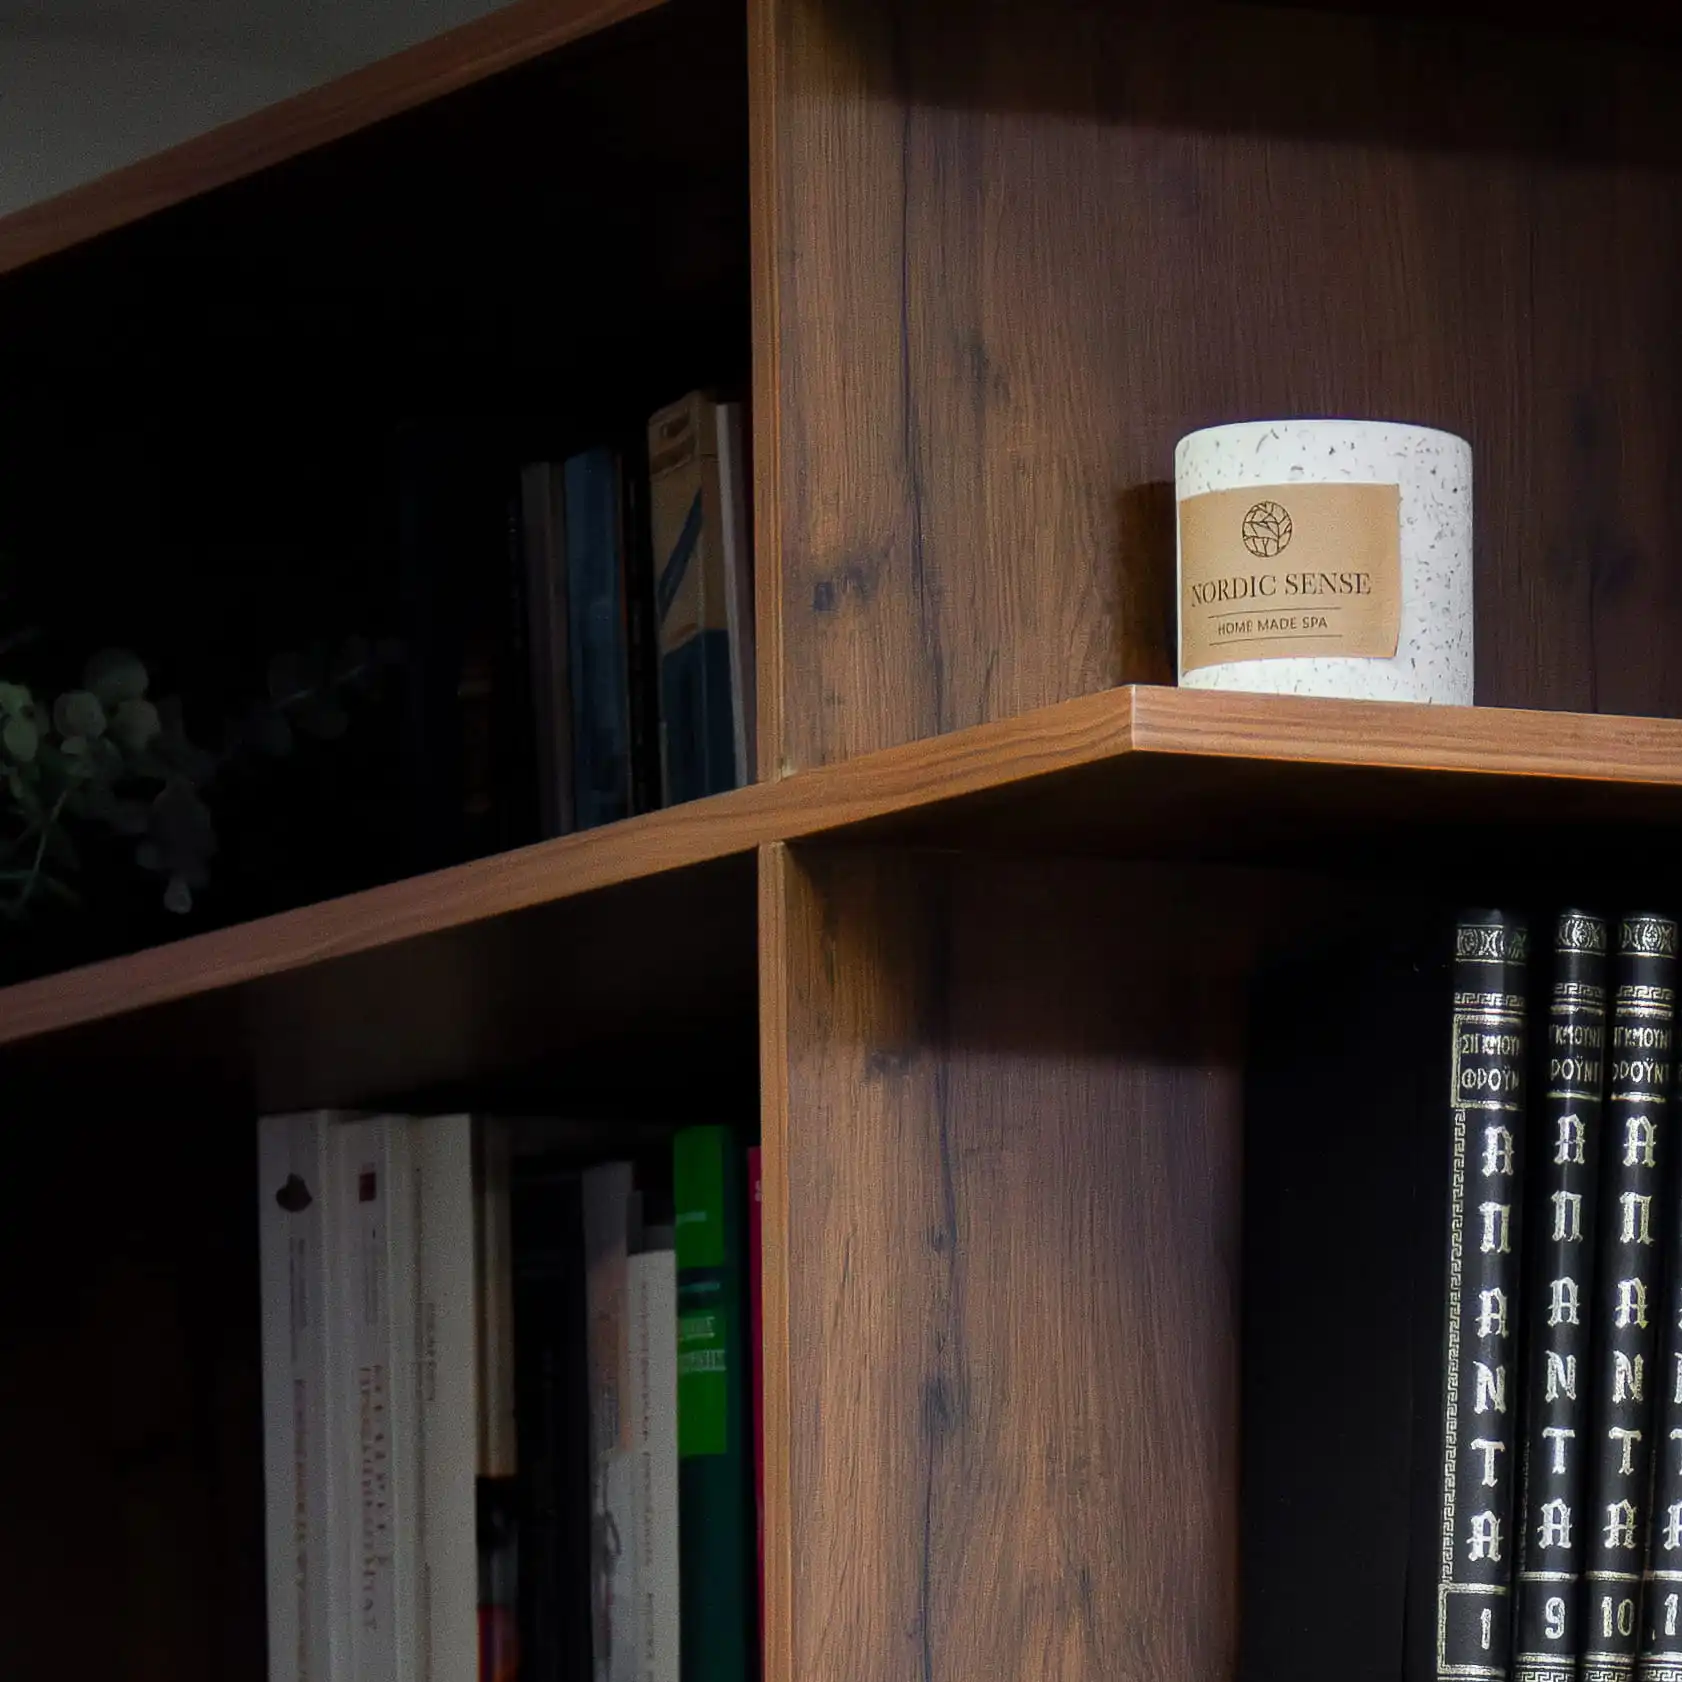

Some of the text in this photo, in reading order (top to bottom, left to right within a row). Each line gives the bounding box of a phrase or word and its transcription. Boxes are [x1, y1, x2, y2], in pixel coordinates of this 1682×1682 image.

[1191, 572, 1371, 607] NORDIC SENSE
[1218, 616, 1328, 636] HOME MADE SPA
[1480, 1607, 1492, 1650] 1
[1545, 1597, 1565, 1640] 9
[1602, 1596, 1635, 1638] 10
